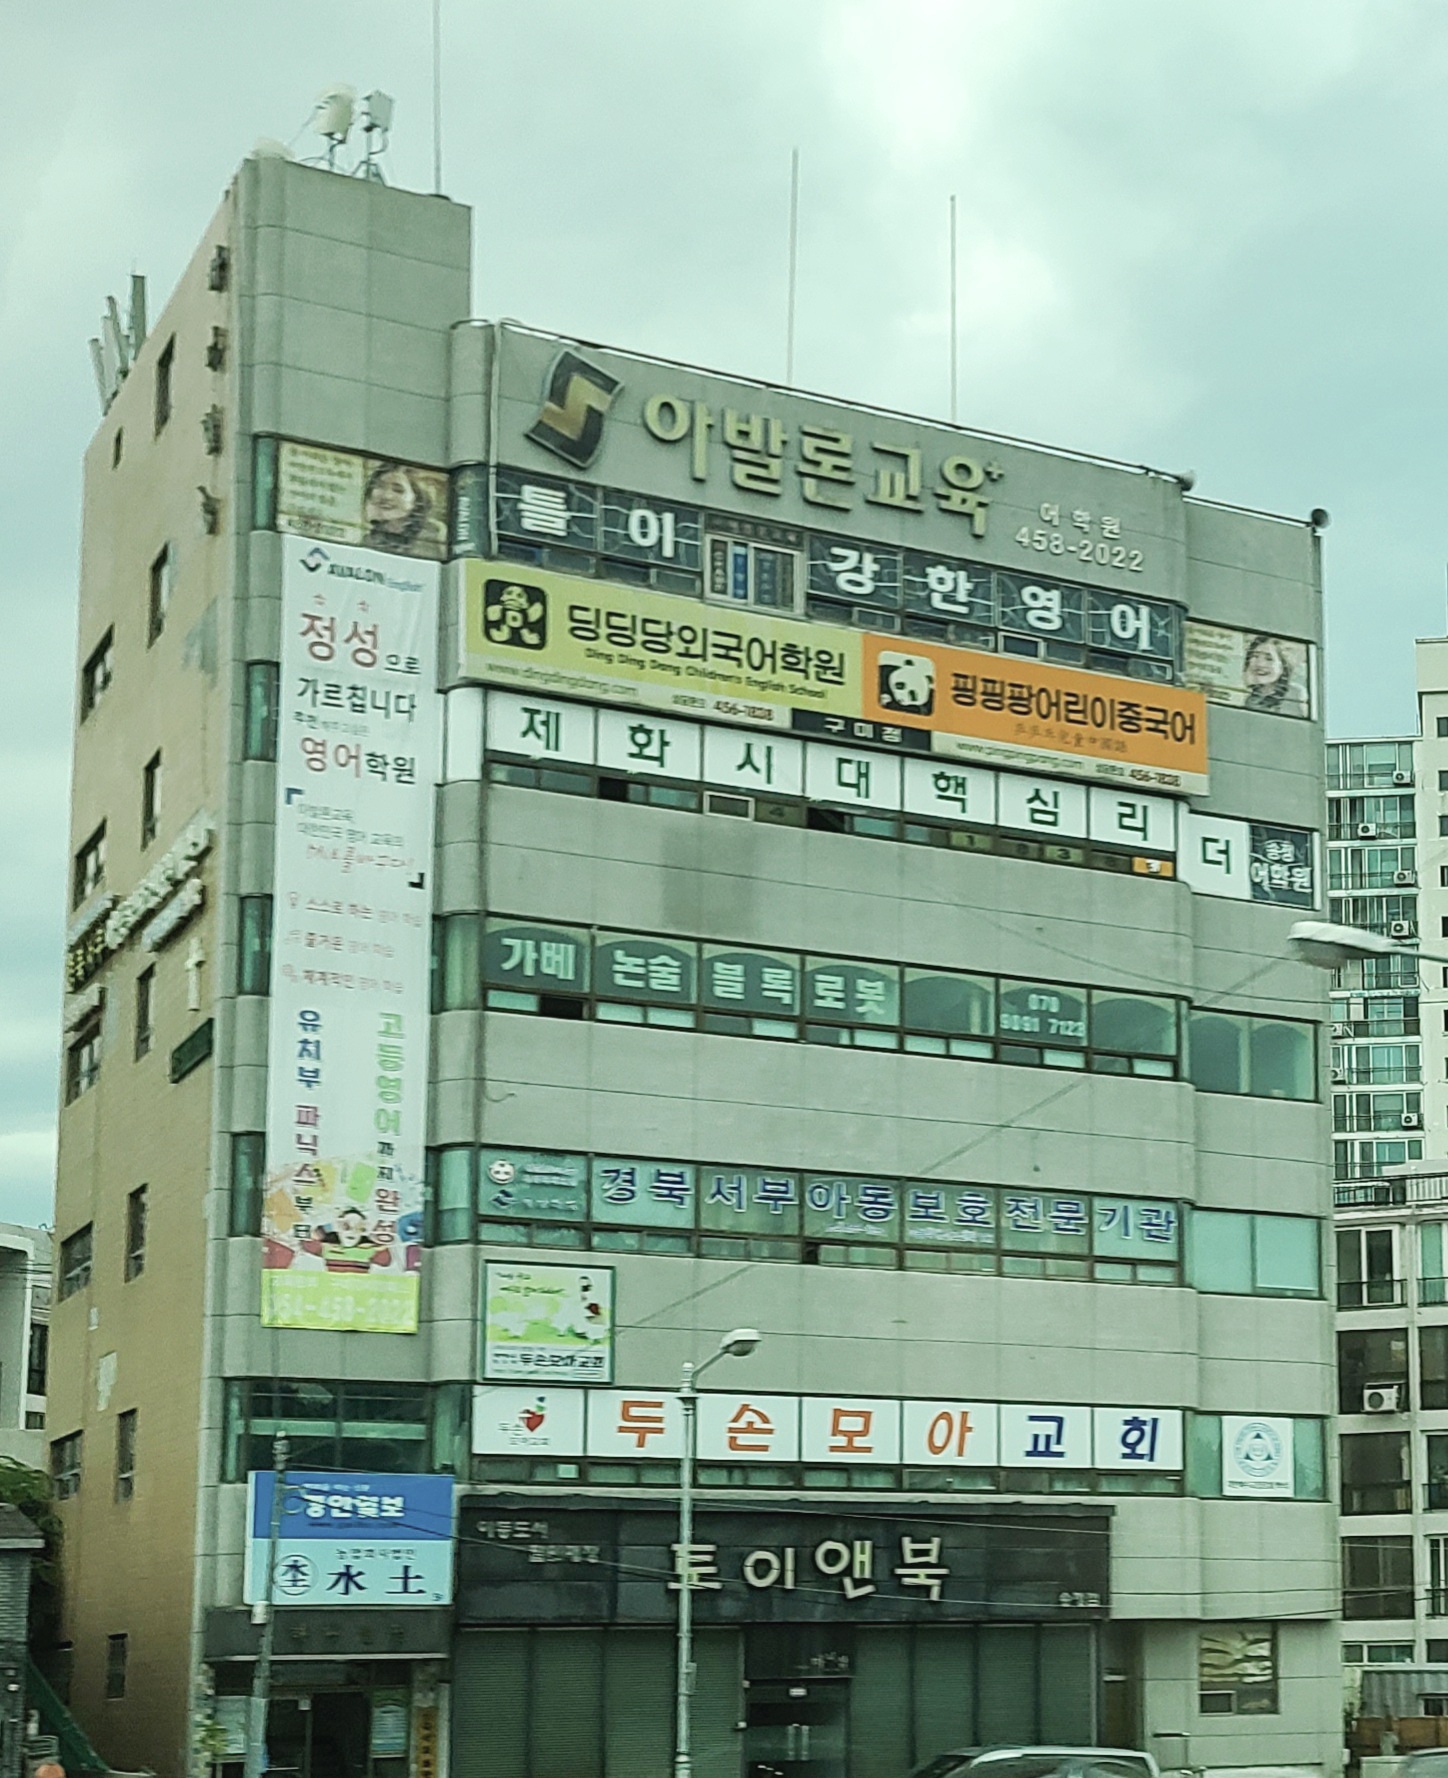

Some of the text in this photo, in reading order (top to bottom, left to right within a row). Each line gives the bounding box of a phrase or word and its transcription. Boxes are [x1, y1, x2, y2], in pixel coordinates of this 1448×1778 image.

[1015, 526, 1145, 573] 458-2022
[568, 603, 847, 686] 딩딩당외국어학원
[584, 648, 613, 664] Ding
[618, 653, 645, 670] Ding
[745, 676, 786, 692] English
[788, 683, 826, 699] School
[297, 678, 418, 722] 가르칩니다
[951, 671, 1196, 746] 핑핑팡어린이중국어
[301, 737, 416, 785] 영어학원
[1251, 862, 1313, 893] 어학원
[500, 937, 576, 981] 가베
[612, 949, 682, 993] 논술
[712, 961, 794, 1006] 블록
[814, 973, 886, 1016] 로봇
[297, 1009, 322, 1089] 유치부
[325, 1564, 427, 1596] 水土
